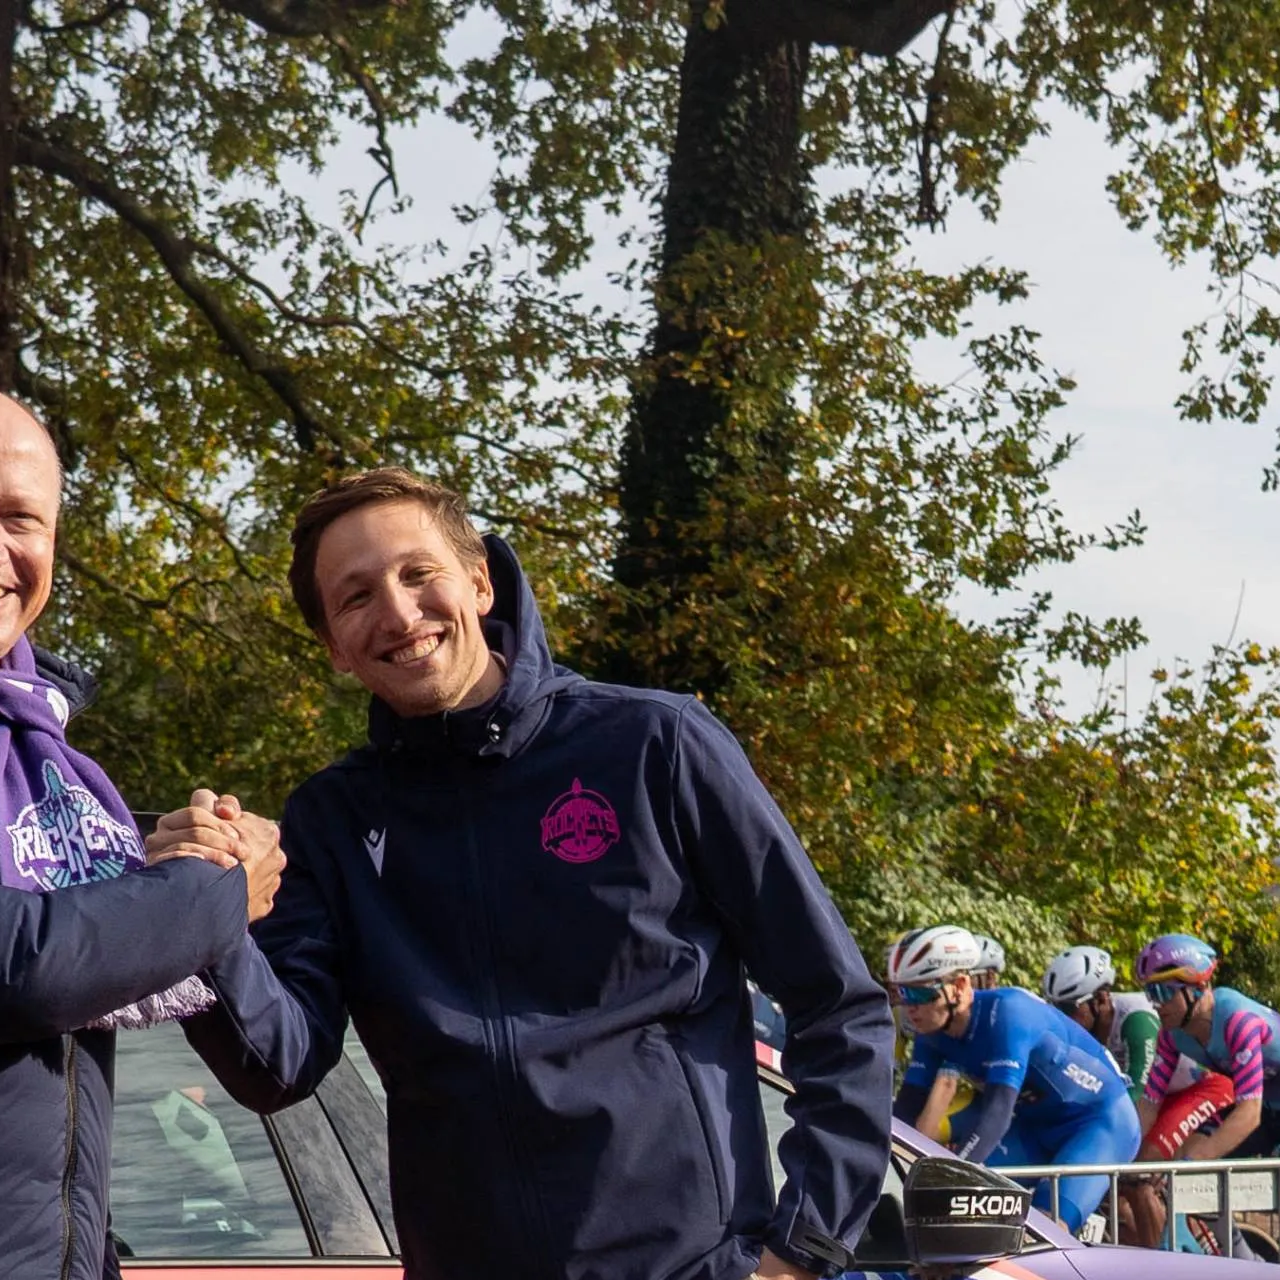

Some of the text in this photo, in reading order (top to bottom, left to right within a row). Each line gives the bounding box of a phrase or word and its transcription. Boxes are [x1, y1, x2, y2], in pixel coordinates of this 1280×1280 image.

[10, 808, 146, 872] ROCKETS
[542, 806, 620, 842] ROCKETS
[1061, 1062, 1104, 1094] SKODA
[1179, 1100, 1216, 1137] POLTI
[949, 1195, 1023, 1216] SKODA
